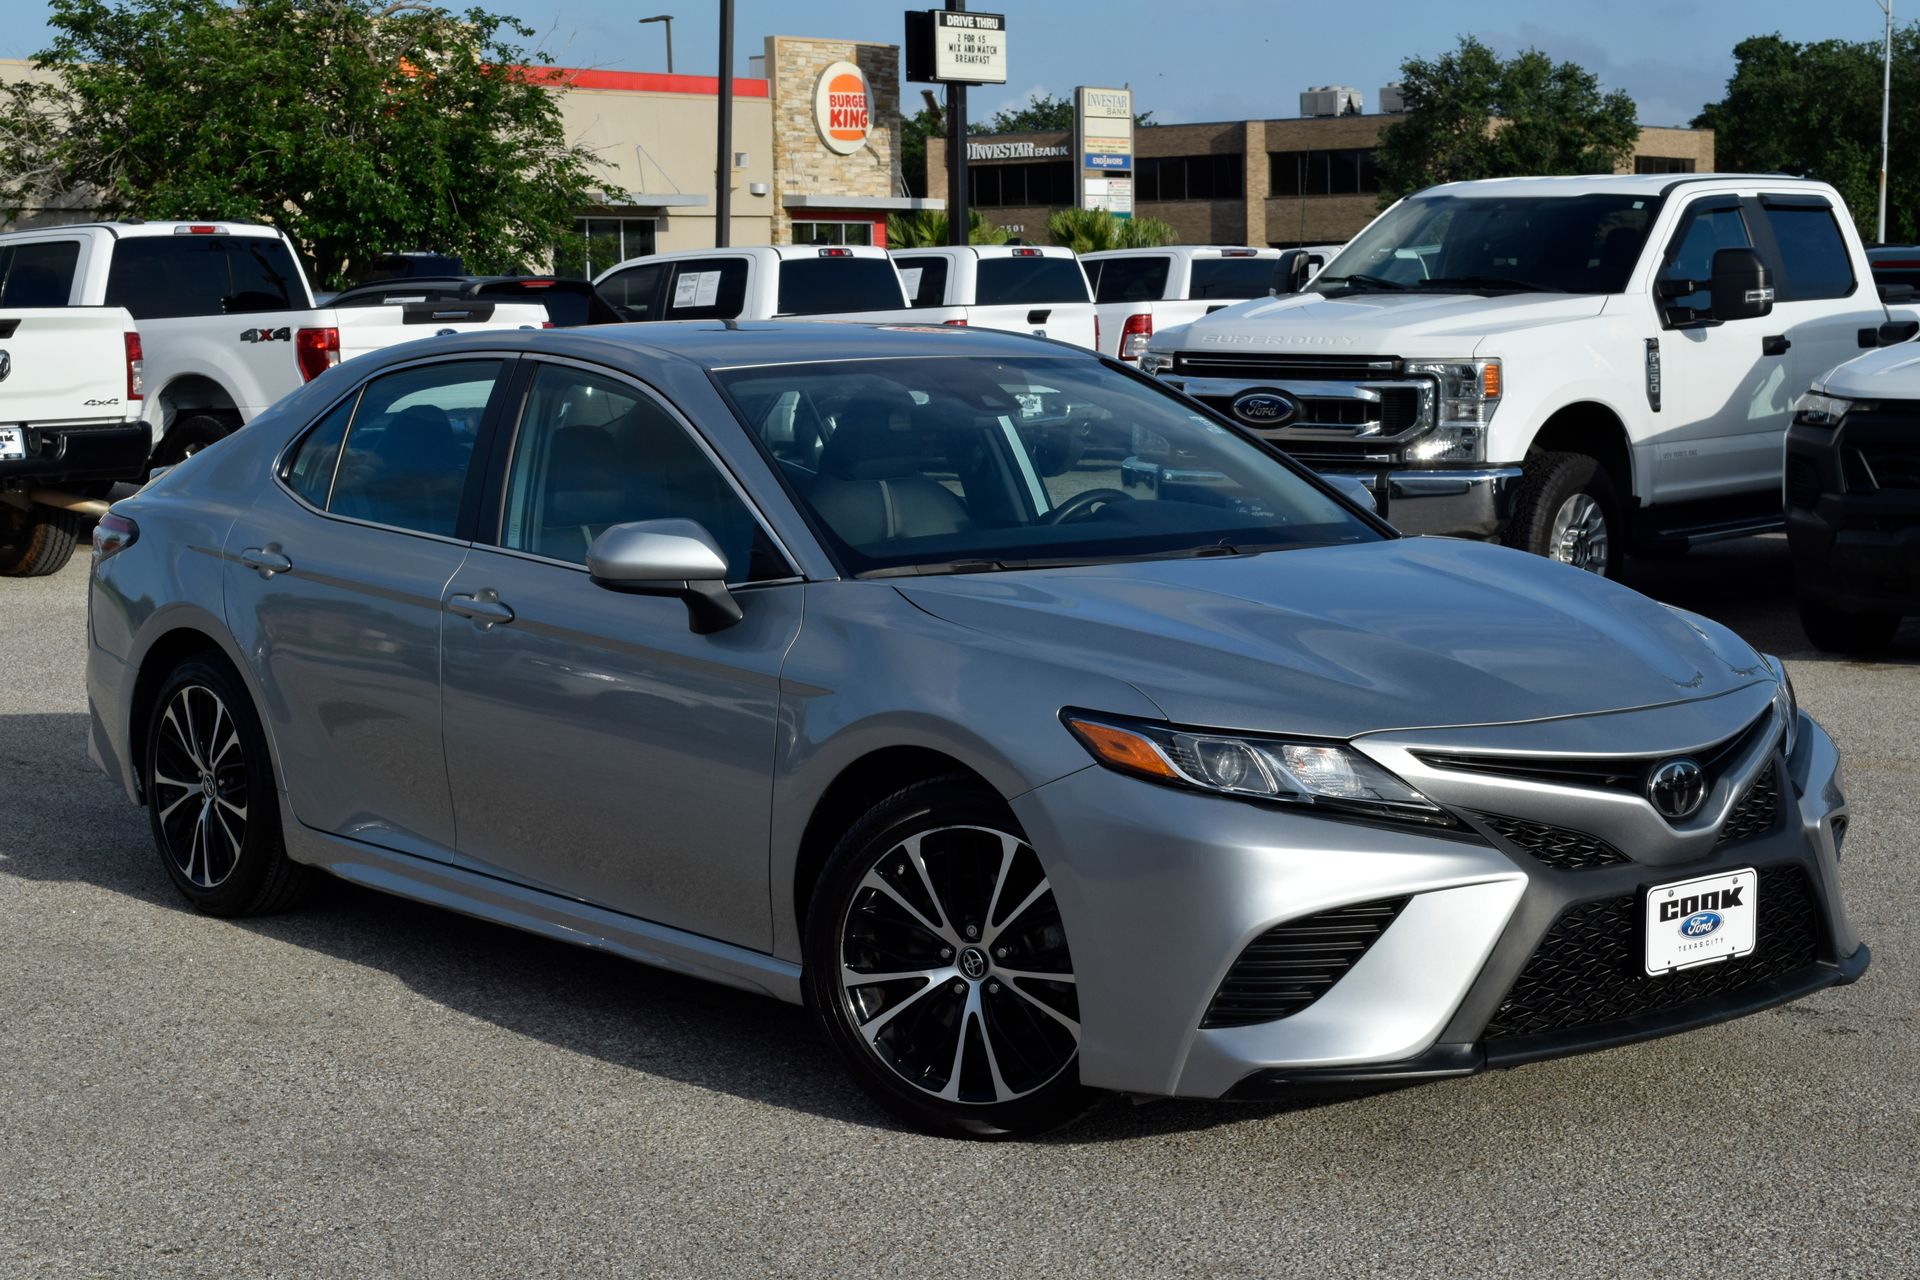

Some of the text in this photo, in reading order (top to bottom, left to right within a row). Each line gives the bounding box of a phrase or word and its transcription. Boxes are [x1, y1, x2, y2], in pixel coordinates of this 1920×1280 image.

[946, 14, 999, 29] DRIVE THRU
[957, 33, 961, 43] 2
[963, 33, 975, 43] FOR
[949, 42, 997, 55] MIX AND MATCH
[955, 54, 990, 64] BREAKFAST
[829, 94, 869, 108] BURGER
[1087, 92, 1127, 108] INVESTAR
[830, 109, 868, 128] KING
[1106, 107, 1127, 116] BANK
[971, 142, 1069, 160] INVESTAR BANK
[1201, 334, 1360, 346] SUPER DUTY
[1246, 399, 1279, 417] Ford
[1660, 886, 1744, 923] COOK
[1688, 916, 1714, 935] Ford
[1678, 937, 1725, 952] TEXAS CITY
